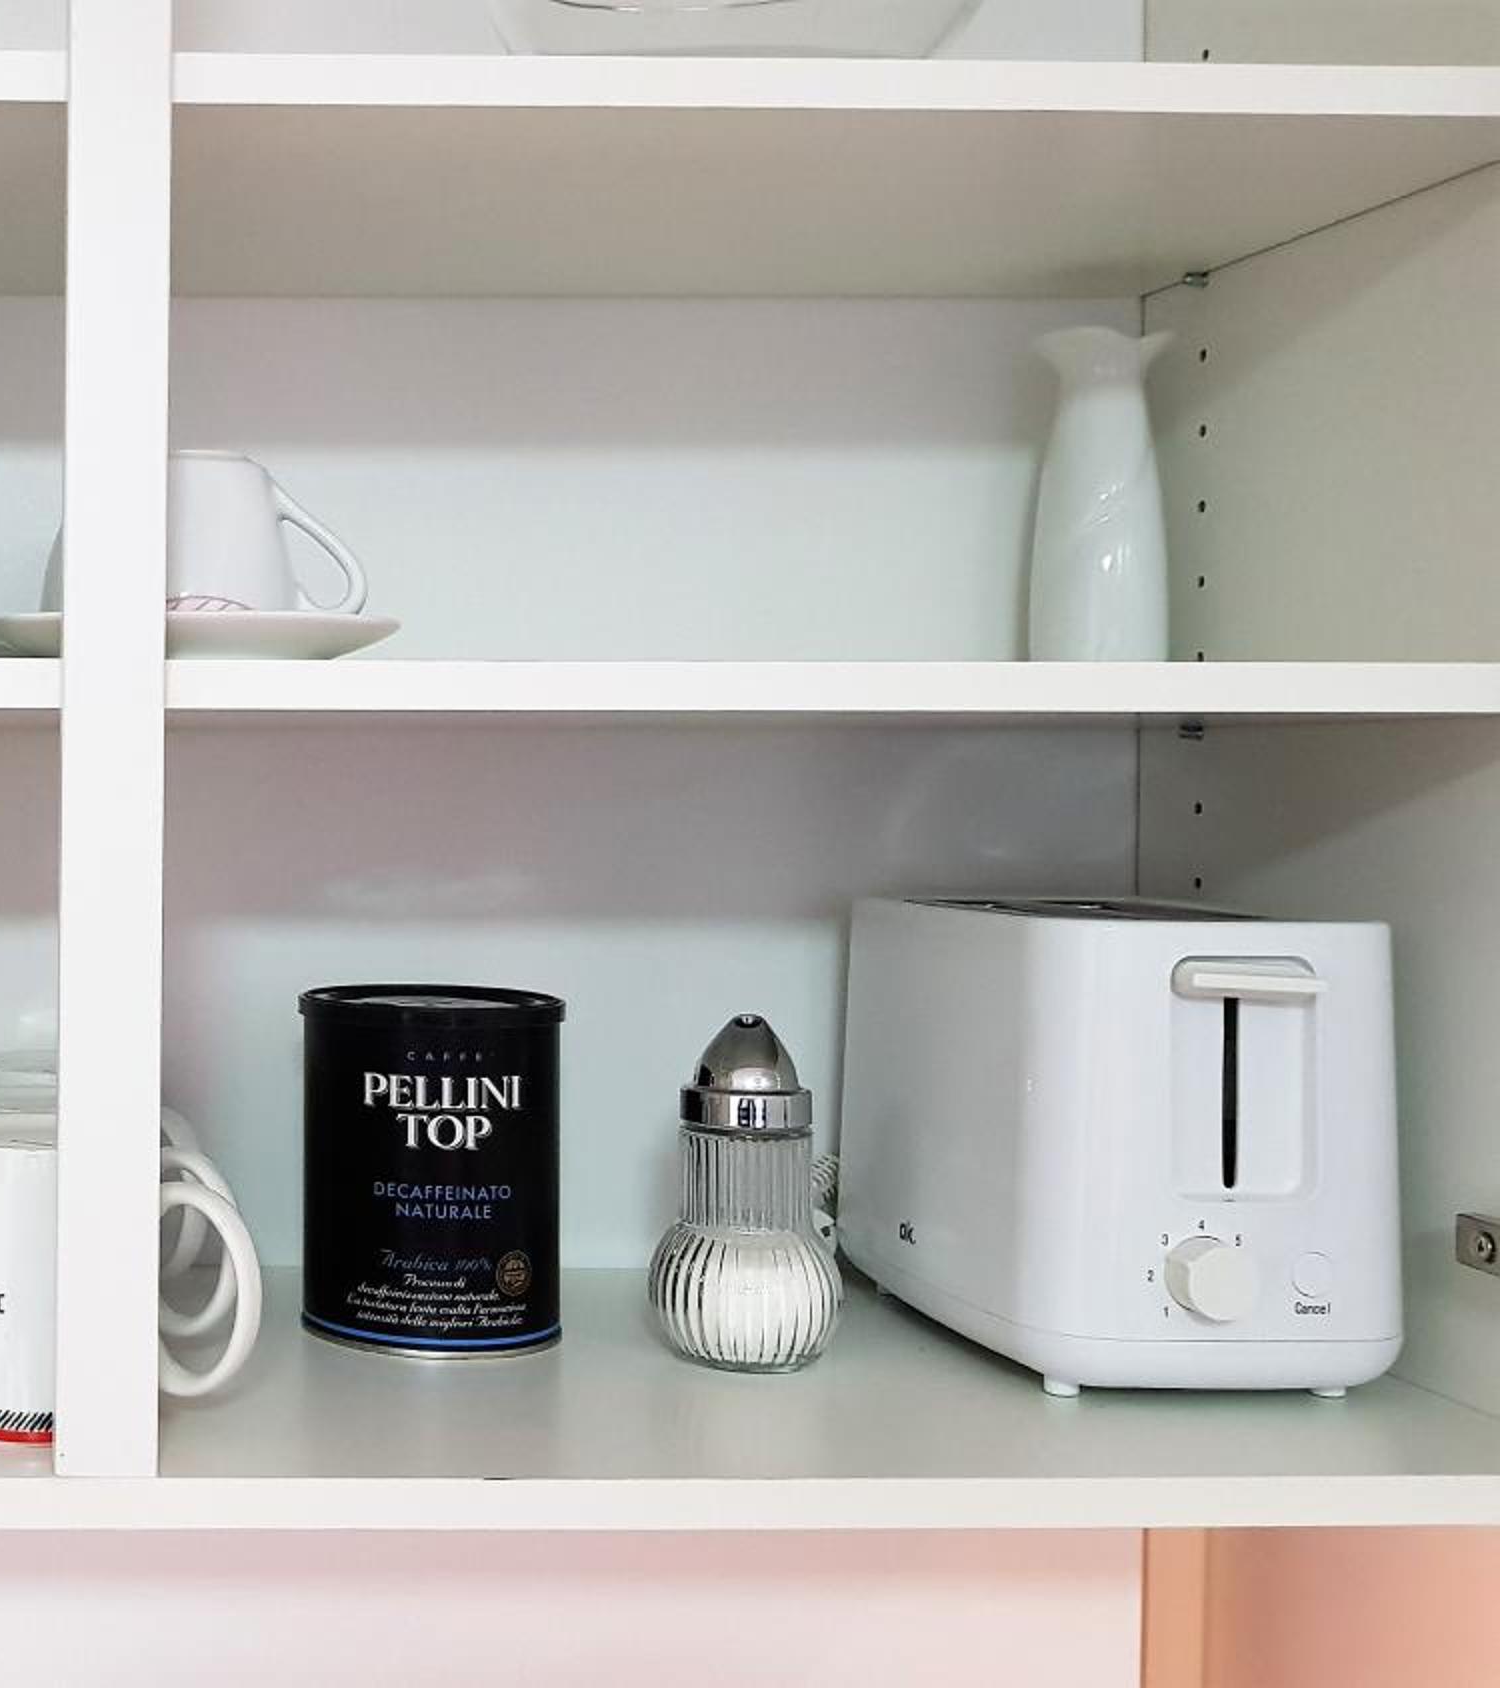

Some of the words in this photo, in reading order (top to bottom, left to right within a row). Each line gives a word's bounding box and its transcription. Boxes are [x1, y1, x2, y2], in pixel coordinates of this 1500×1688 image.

[363, 1071, 522, 1111] PELLINI
[396, 1112, 493, 1151] TOP
[373, 1181, 512, 1202] DECAFFEINATO
[395, 1202, 493, 1220] NATURALE
[1197, 1219, 1205, 1231] 4
[1161, 1233, 1169, 1246] 3
[1235, 1233, 1242, 1247] 5
[1147, 1269, 1155, 1283] 2
[1164, 1305, 1169, 1317] 1
[1294, 1302, 1332, 1315] Cancel
